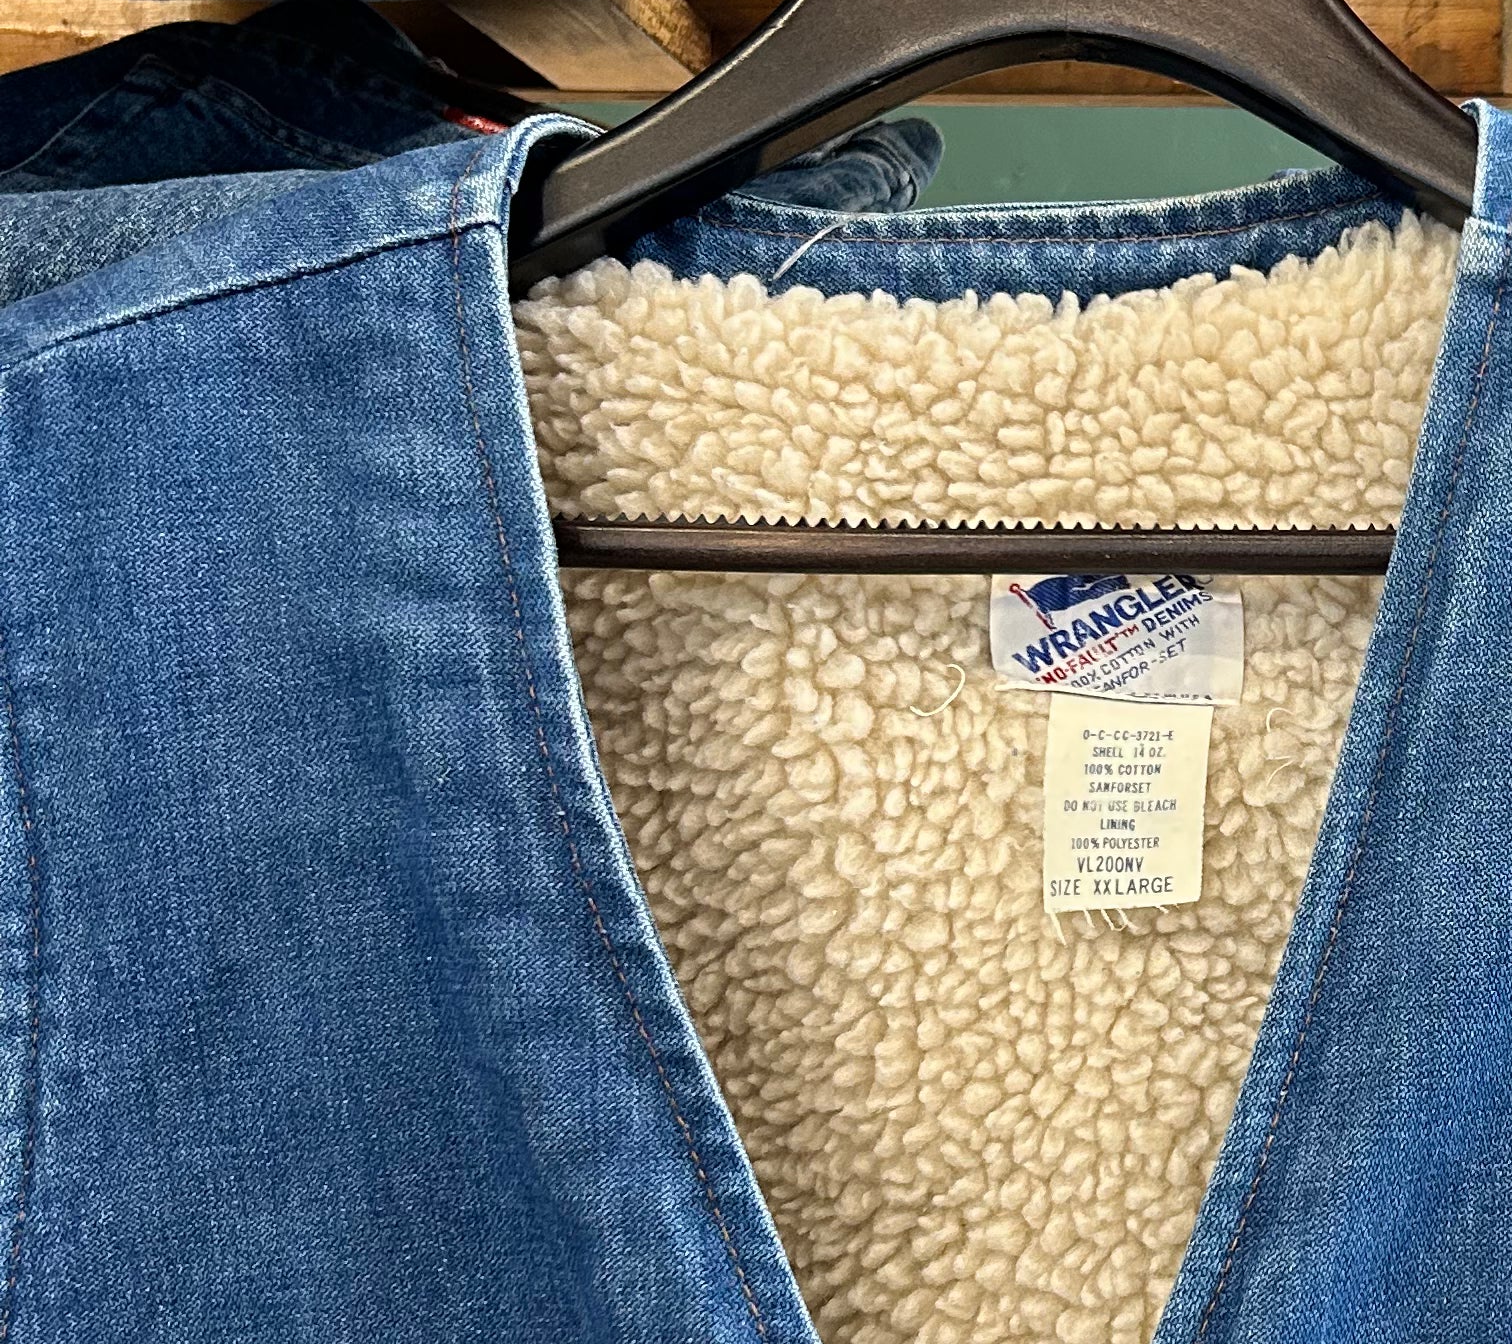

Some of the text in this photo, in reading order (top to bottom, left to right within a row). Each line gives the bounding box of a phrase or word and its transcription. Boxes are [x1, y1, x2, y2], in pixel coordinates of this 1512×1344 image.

[1142, 591, 1213, 632] DENIMS
[1011, 574, 1204, 673] WRANGLER
[1100, 638, 1156, 675] COTTON
[1159, 614, 1200, 641] WITH
[1093, 638, 1187, 692] ANFOR-SET
[1092, 746, 1124, 758] SHELL
[1084, 763, 1161, 775] 100% COTTON
[1089, 781, 1151, 793] SANFORSET
[1064, 798, 1177, 812] DO NOT USE BLEACH
[1100, 818, 1135, 831] LINING
[1071, 836, 1160, 849] 100% POLYESTER
[1050, 875, 1174, 897] SIZE XXLARGE
